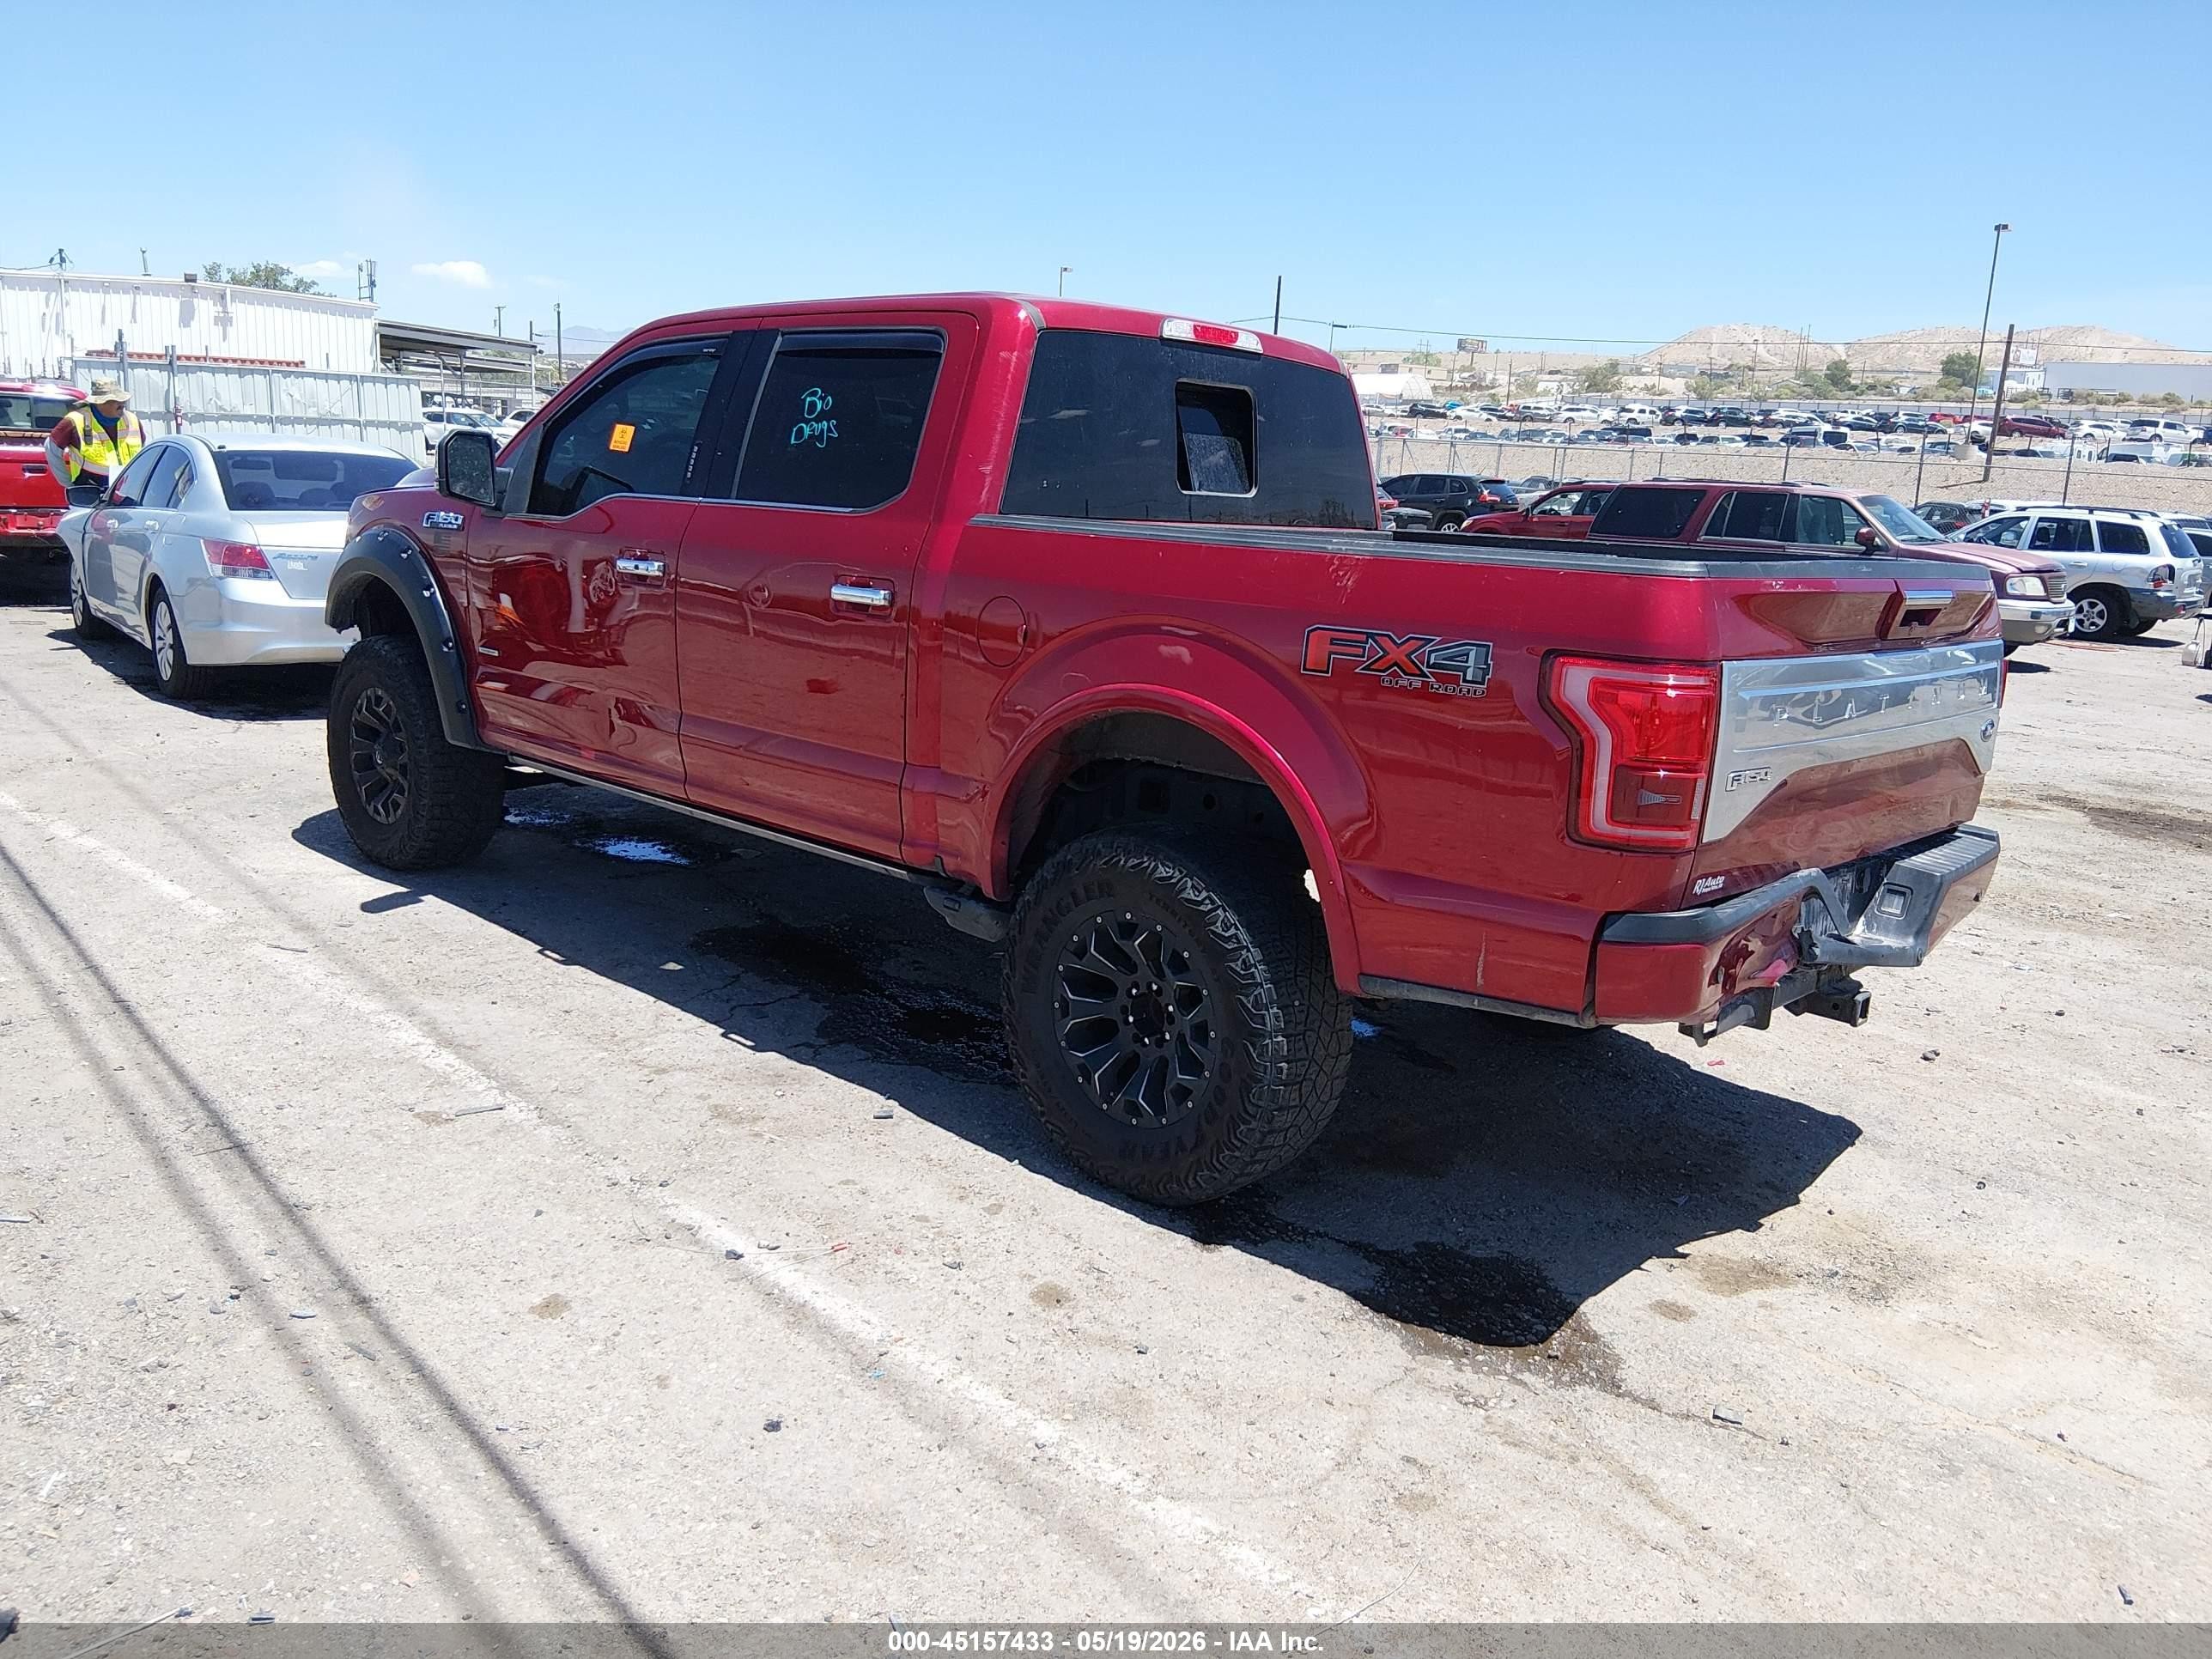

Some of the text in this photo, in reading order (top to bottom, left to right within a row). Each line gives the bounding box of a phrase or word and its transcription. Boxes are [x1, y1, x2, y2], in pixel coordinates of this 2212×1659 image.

[800, 387, 833, 419] Bio
[1301, 624, 1493, 688] FX4
[1380, 676, 1487, 698] OFF ROAD
